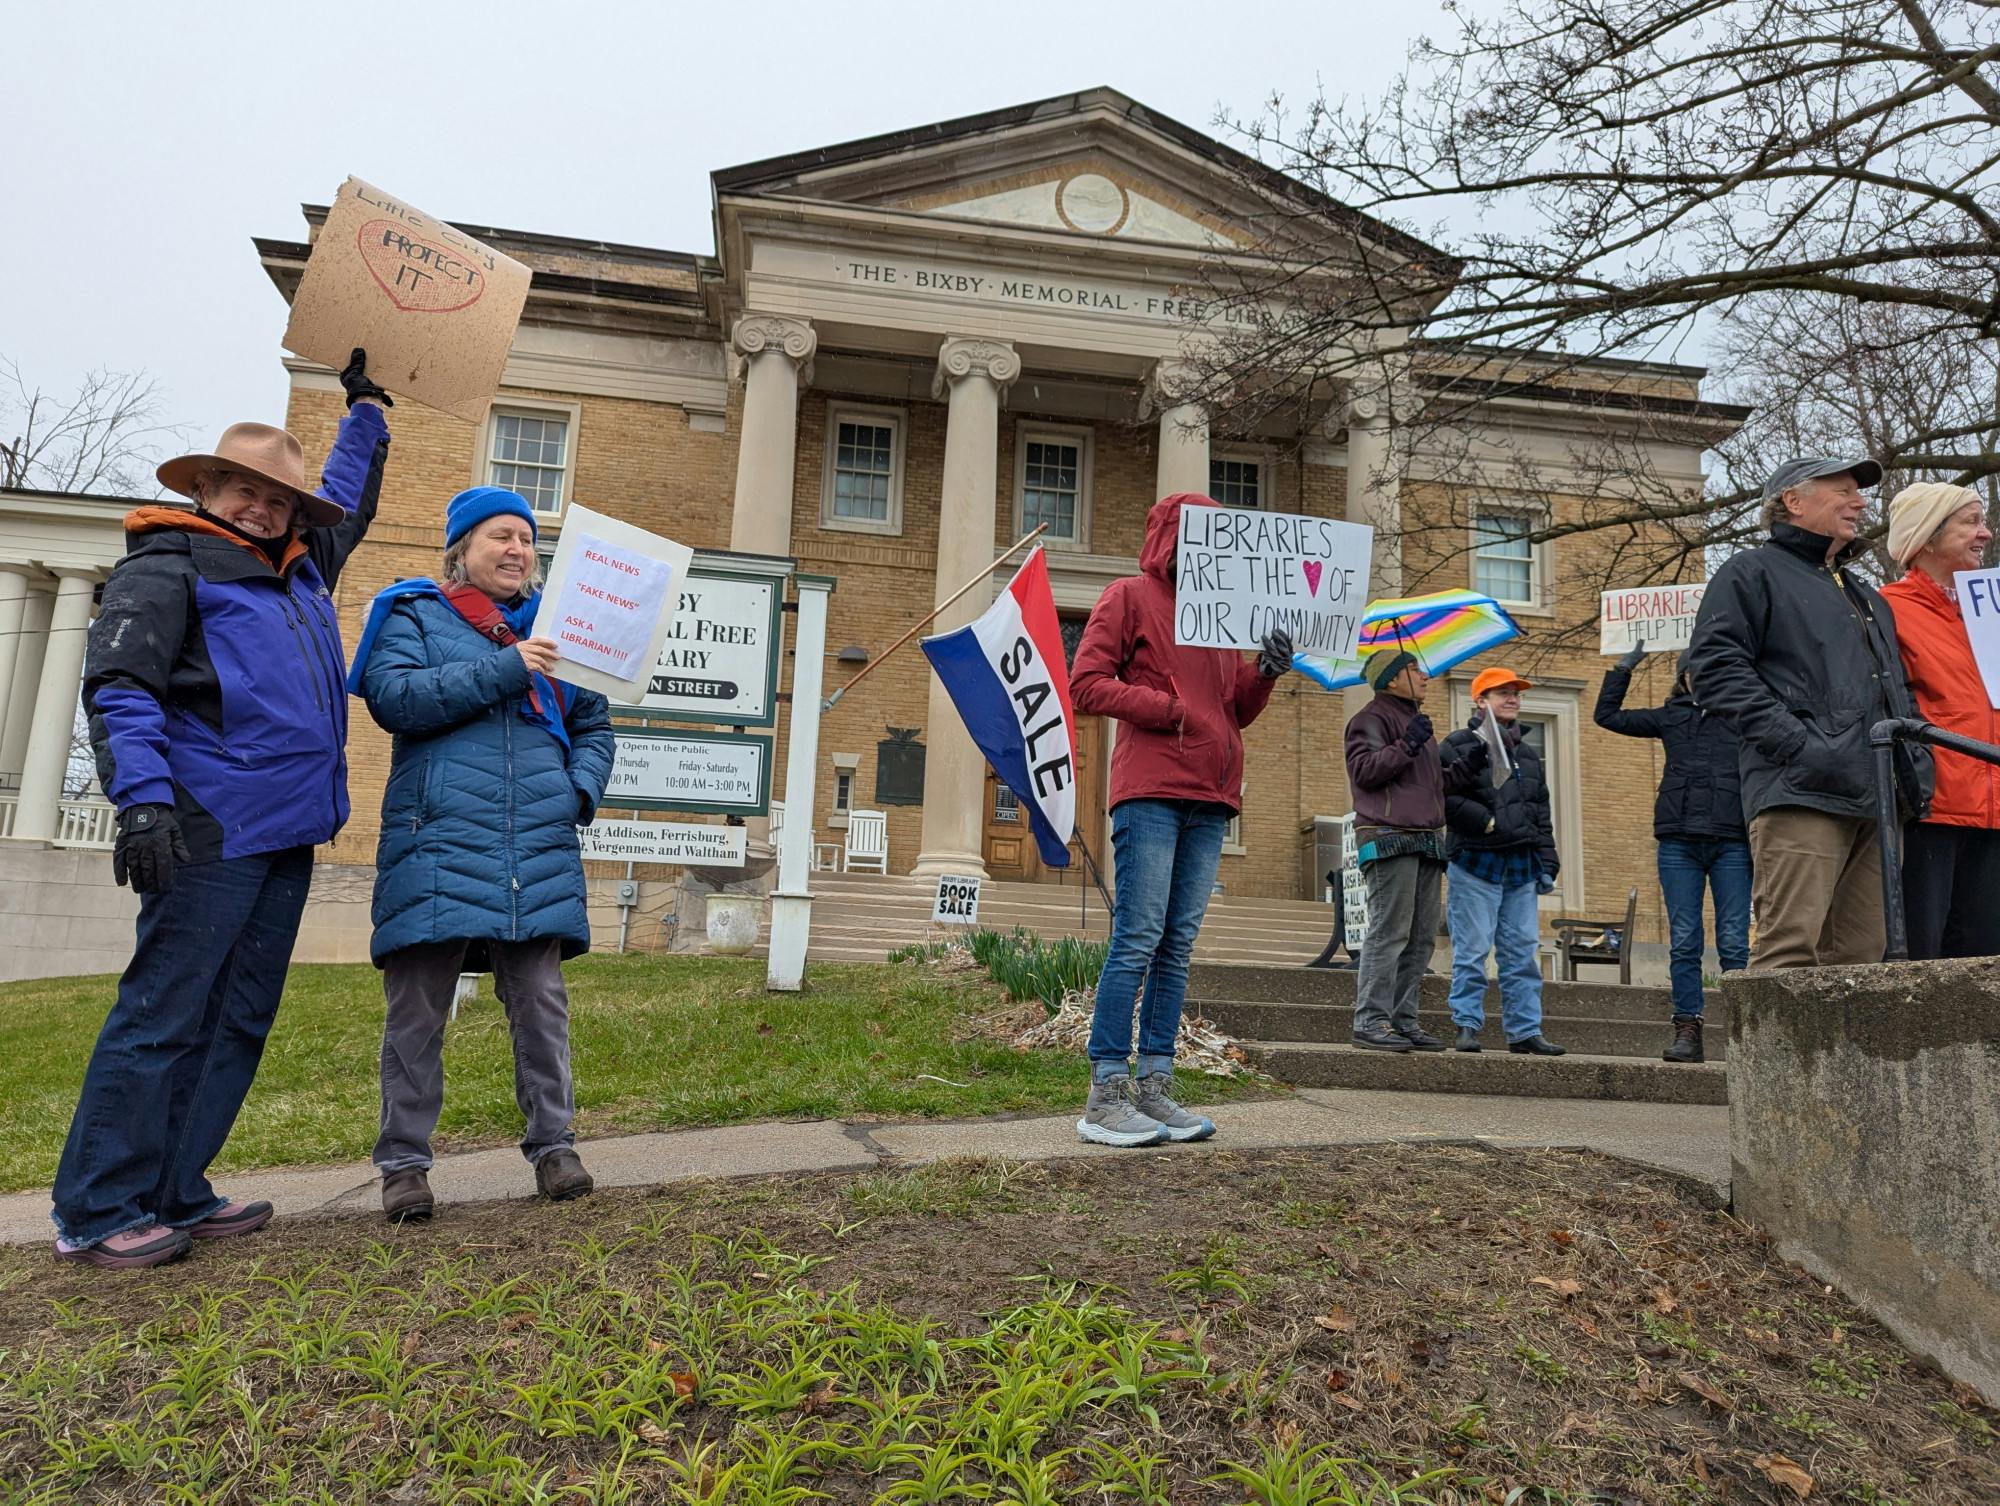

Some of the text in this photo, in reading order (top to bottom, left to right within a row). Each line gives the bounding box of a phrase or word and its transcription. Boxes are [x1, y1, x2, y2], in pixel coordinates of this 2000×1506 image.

[383, 229, 480, 286] PROTECT
[396, 264, 434, 292] IT
[849, 263, 896, 283] THE
[915, 271, 984, 293] BIXBY
[1001, 281, 1128, 311] MEMORIAL
[1147, 298, 1206, 320] FREE
[1184, 510, 1332, 559] LIBRARIES
[585, 550, 641, 577] REAL NEWS
[1179, 552, 1355, 604] ARE THE OF
[1606, 589, 1704, 622] LIBRARIES
[565, 615, 594, 632] ASK A
[695, 619, 757, 645] FREE
[1180, 602, 1356, 654] OUR COMMUNITY
[1627, 619, 1666, 642] HELP
[560, 630, 612, 655] LIBRARIAN
[667, 680, 722, 696] STREET
[1000, 636, 1072, 799] SALE
[622, 741, 710, 755] Open to the Public
[624, 773, 638, 786] PM
[665, 776, 690, 789] 10:00
[737, 781, 750, 793] PM
[604, 826, 657, 840] Addison,
[661, 829, 729, 846] Ferrisburg,
[592, 841, 655, 856] Vergennes
[658, 845, 681, 857] and
[685, 845, 738, 859] Waltham
[939, 884, 977, 900] BOOK
[938, 899, 973, 916] SALE
